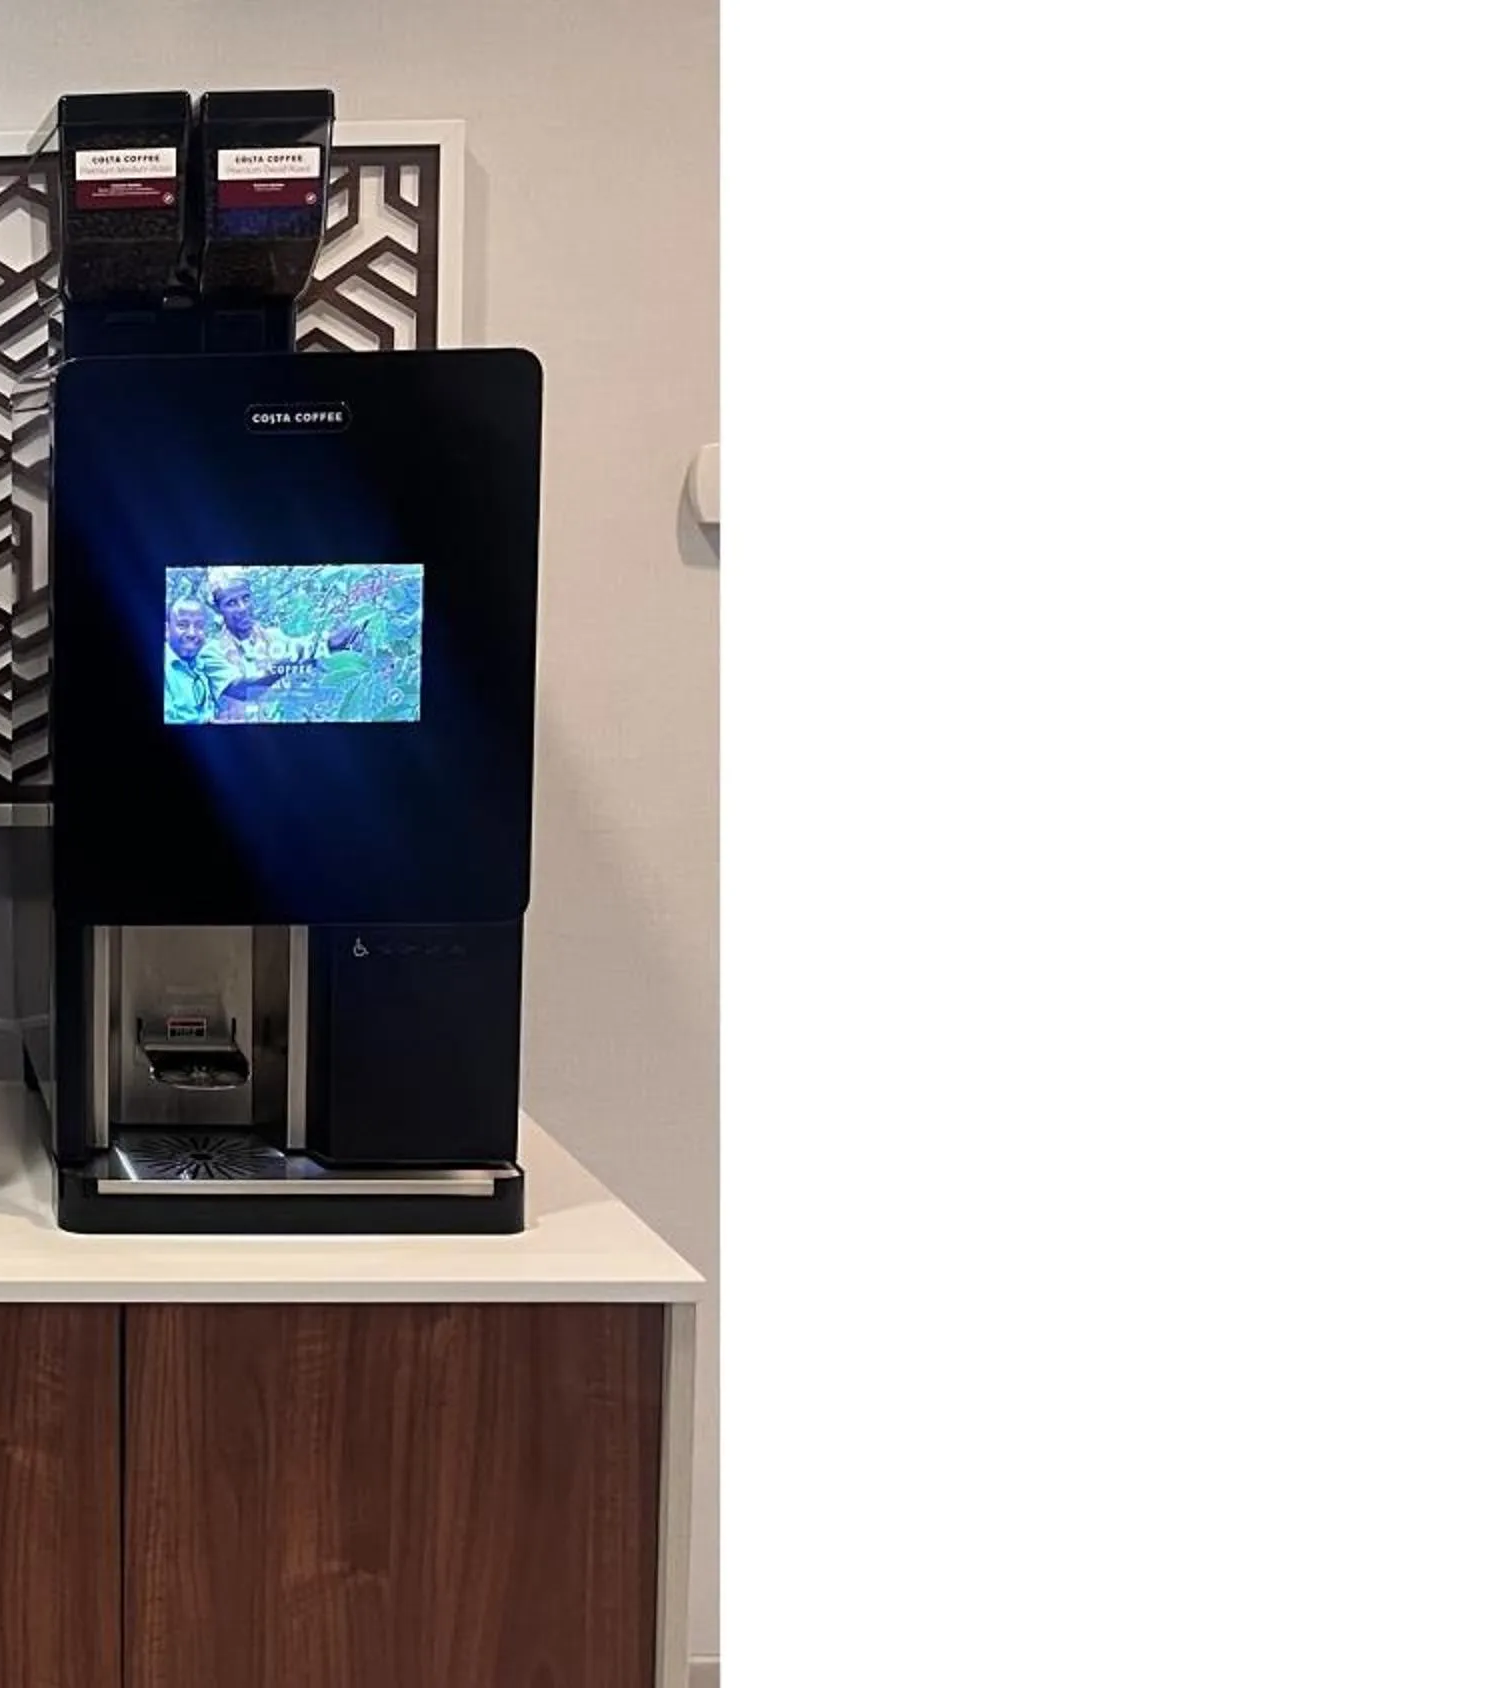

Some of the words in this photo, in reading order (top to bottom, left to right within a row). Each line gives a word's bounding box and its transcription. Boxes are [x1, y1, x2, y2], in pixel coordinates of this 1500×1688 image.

[91, 155, 121, 164] COSTA
[124, 154, 160, 163] COFFEE
[235, 155, 264, 164] COSTA
[267, 154, 302, 163] COFFEE
[251, 412, 291, 424] COSTA
[295, 411, 343, 422] COFFEE
